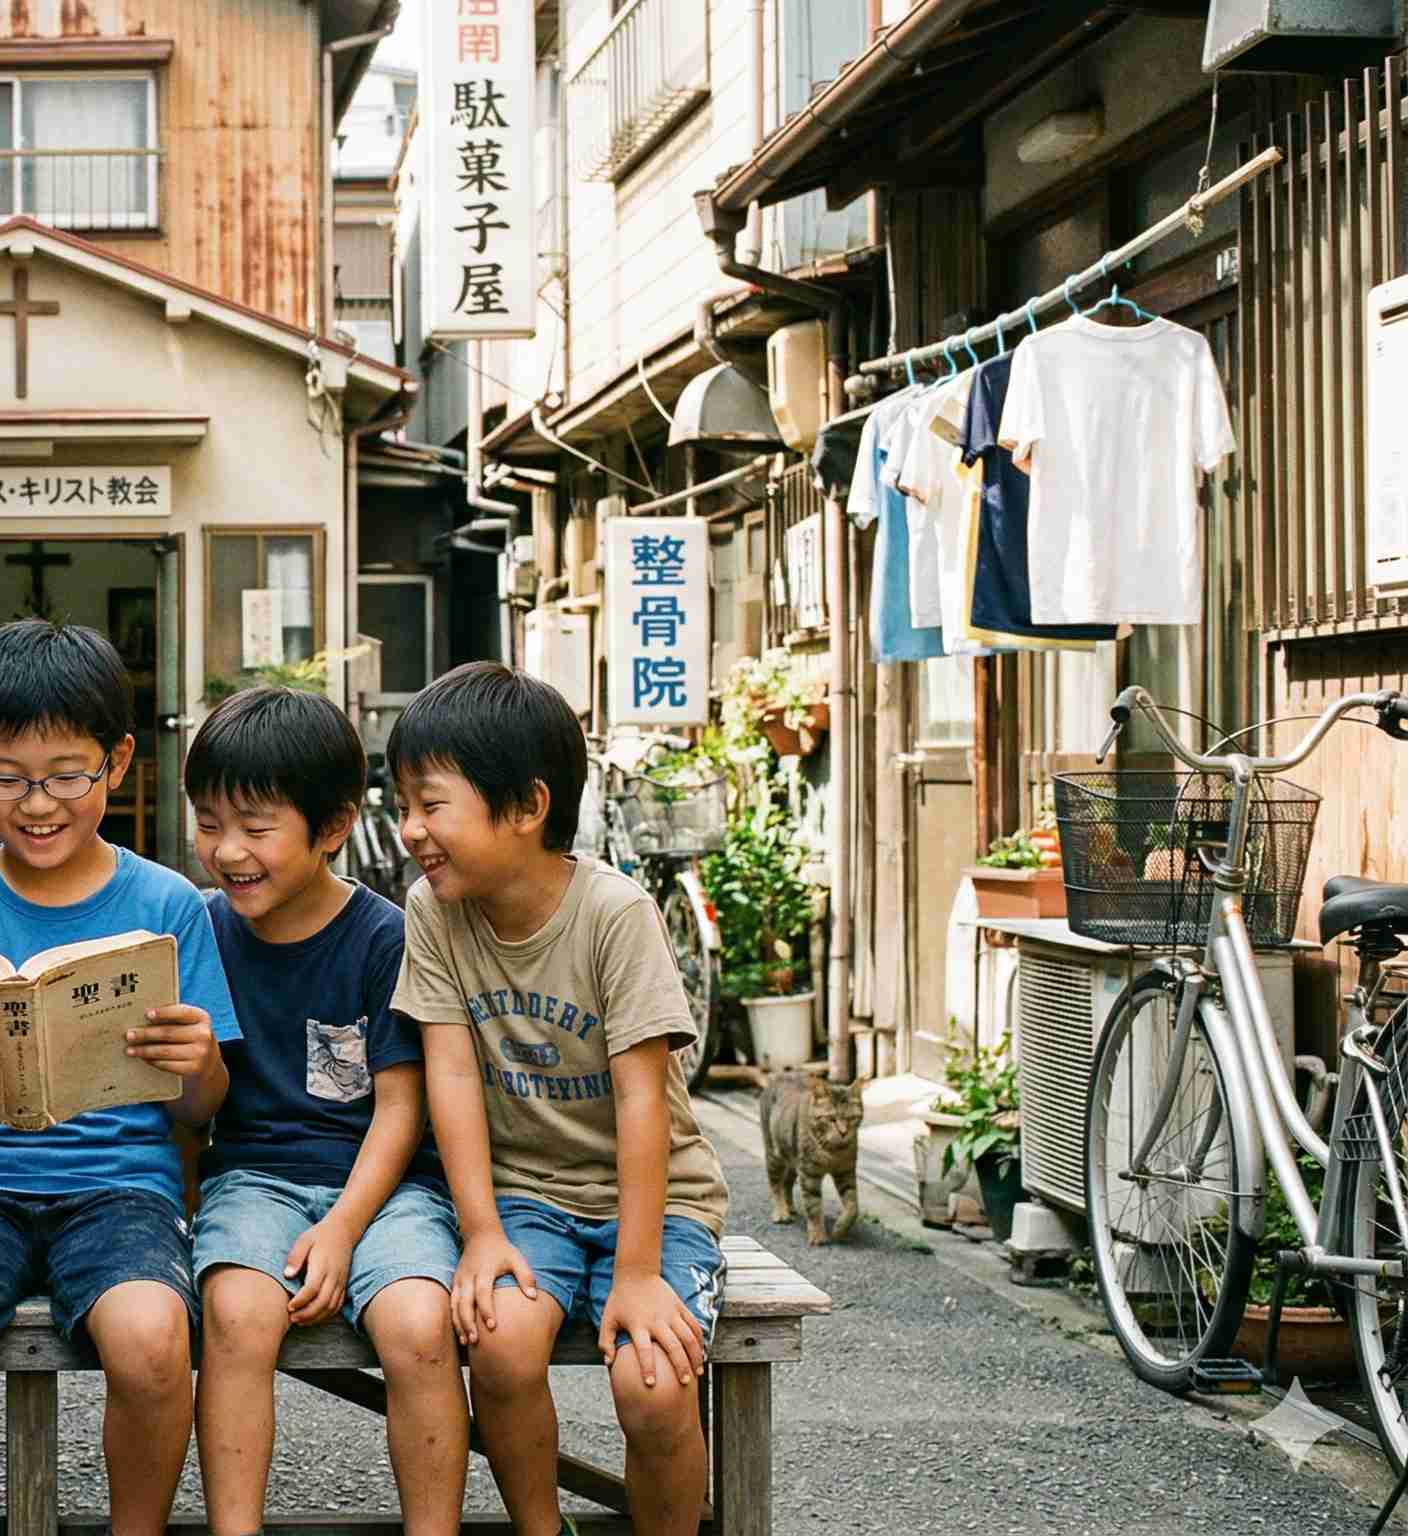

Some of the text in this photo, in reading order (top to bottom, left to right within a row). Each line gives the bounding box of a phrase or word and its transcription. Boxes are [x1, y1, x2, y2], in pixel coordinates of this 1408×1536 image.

[450, 79, 510, 315] 駄菓子屋
[631, 535, 687, 708] 整骨院
[71, 973, 139, 1008] 聖書
